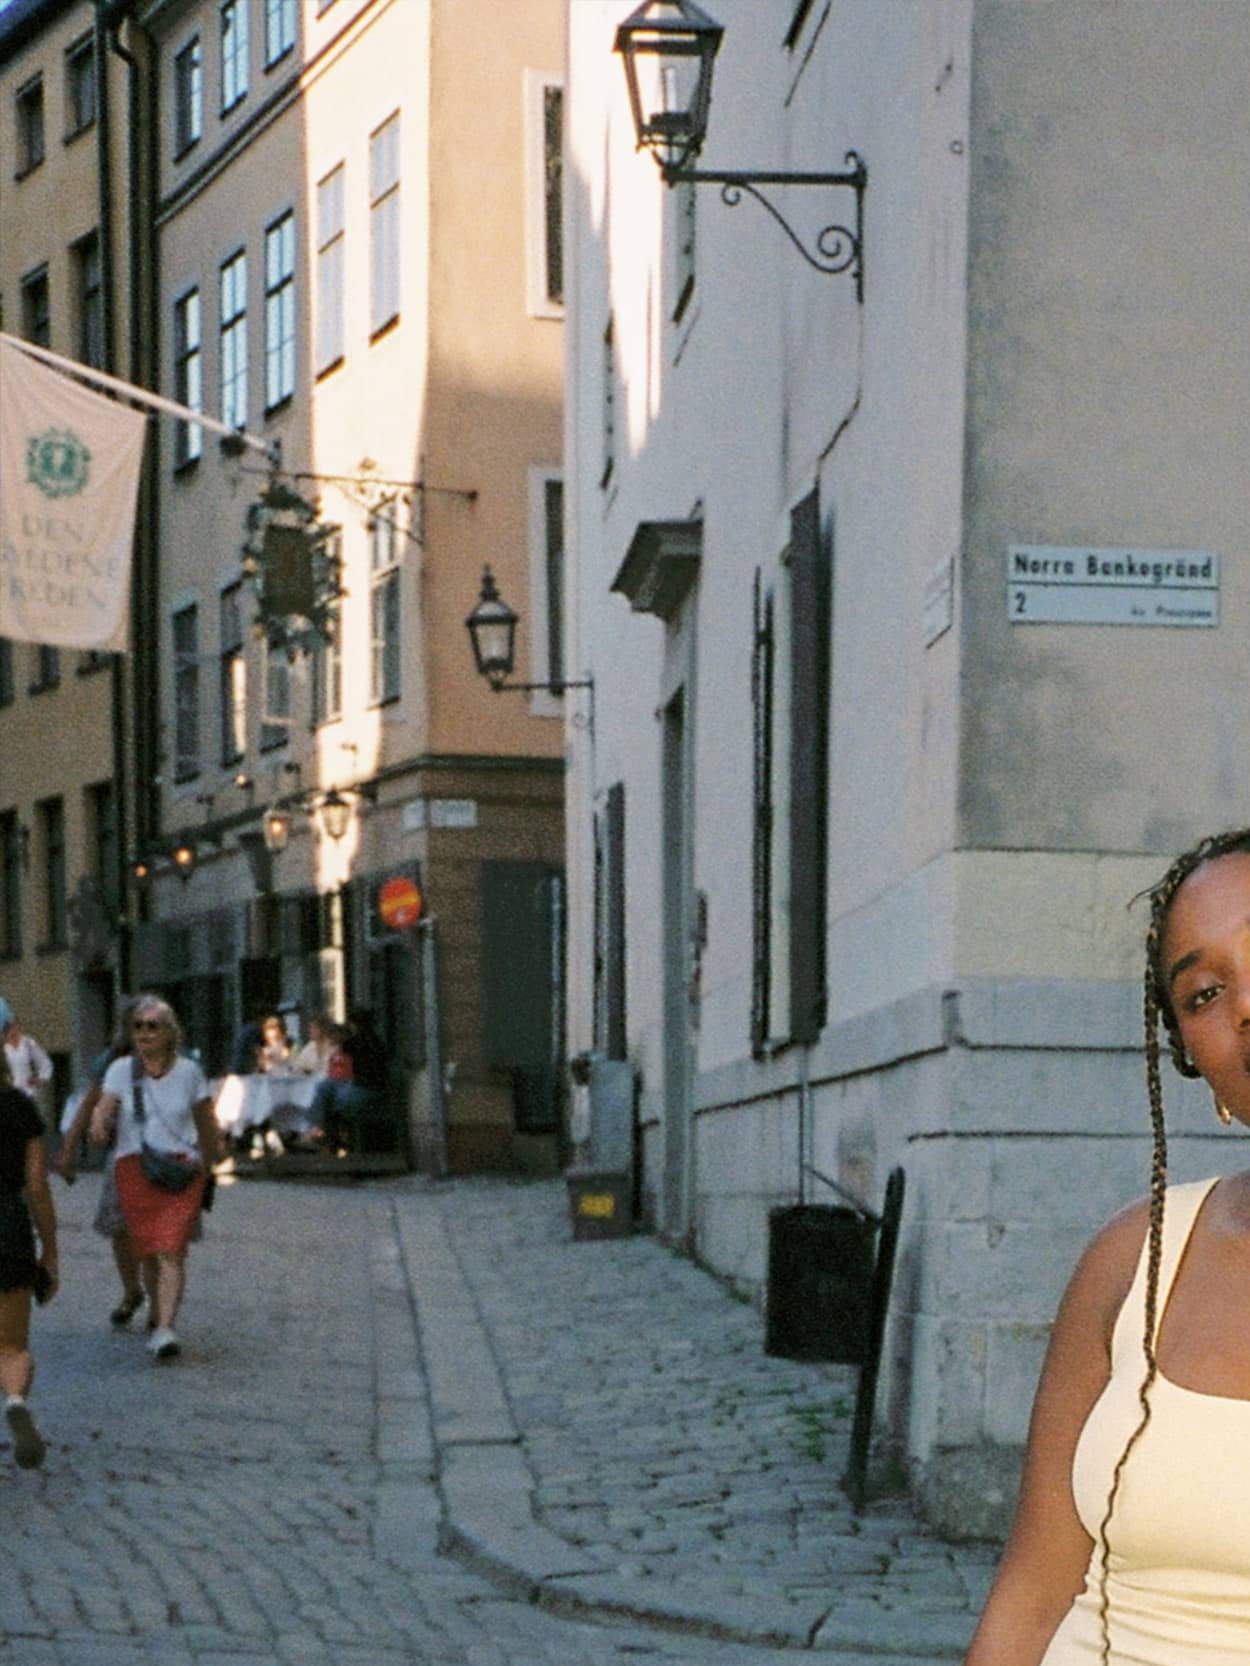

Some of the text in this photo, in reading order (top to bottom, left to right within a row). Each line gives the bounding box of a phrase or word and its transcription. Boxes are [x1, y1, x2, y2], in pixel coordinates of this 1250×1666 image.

[1015, 554, 1212, 583] Norra Bankogränd
[1015, 592, 1027, 614] 2
